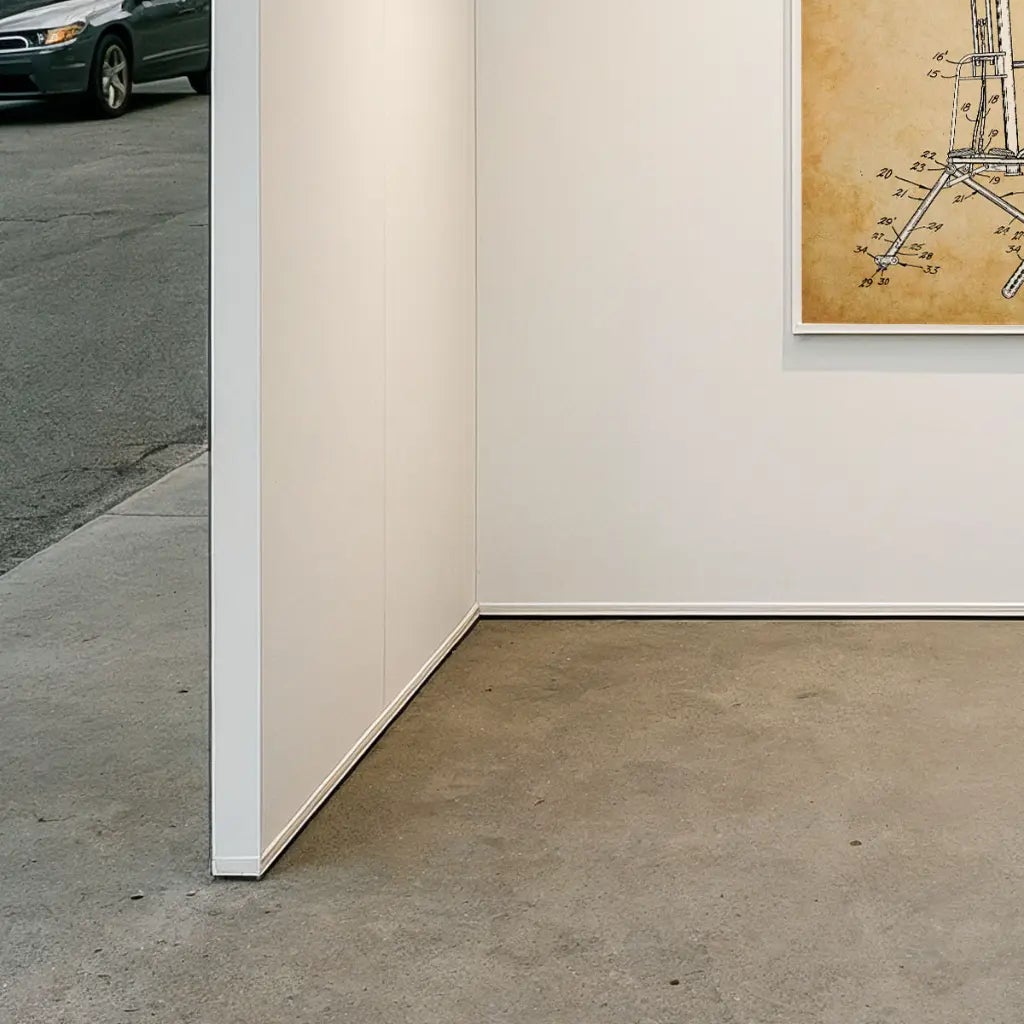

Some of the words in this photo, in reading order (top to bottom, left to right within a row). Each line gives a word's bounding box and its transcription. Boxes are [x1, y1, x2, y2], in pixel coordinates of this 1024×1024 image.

[926, 69, 941, 78] 15
[988, 94, 1000, 104] 18
[960, 102, 971, 112] 18
[920, 150, 937, 160] 22
[910, 161, 926, 172] 23
[876, 168, 893, 179] 20
[988, 176, 1001, 185] 19
[892, 188, 909, 198] 21
[952, 195, 965, 204] 21
[918, 251, 934, 260] 28
[858, 278, 873, 288] 29
[877, 277, 890, 286] 30
